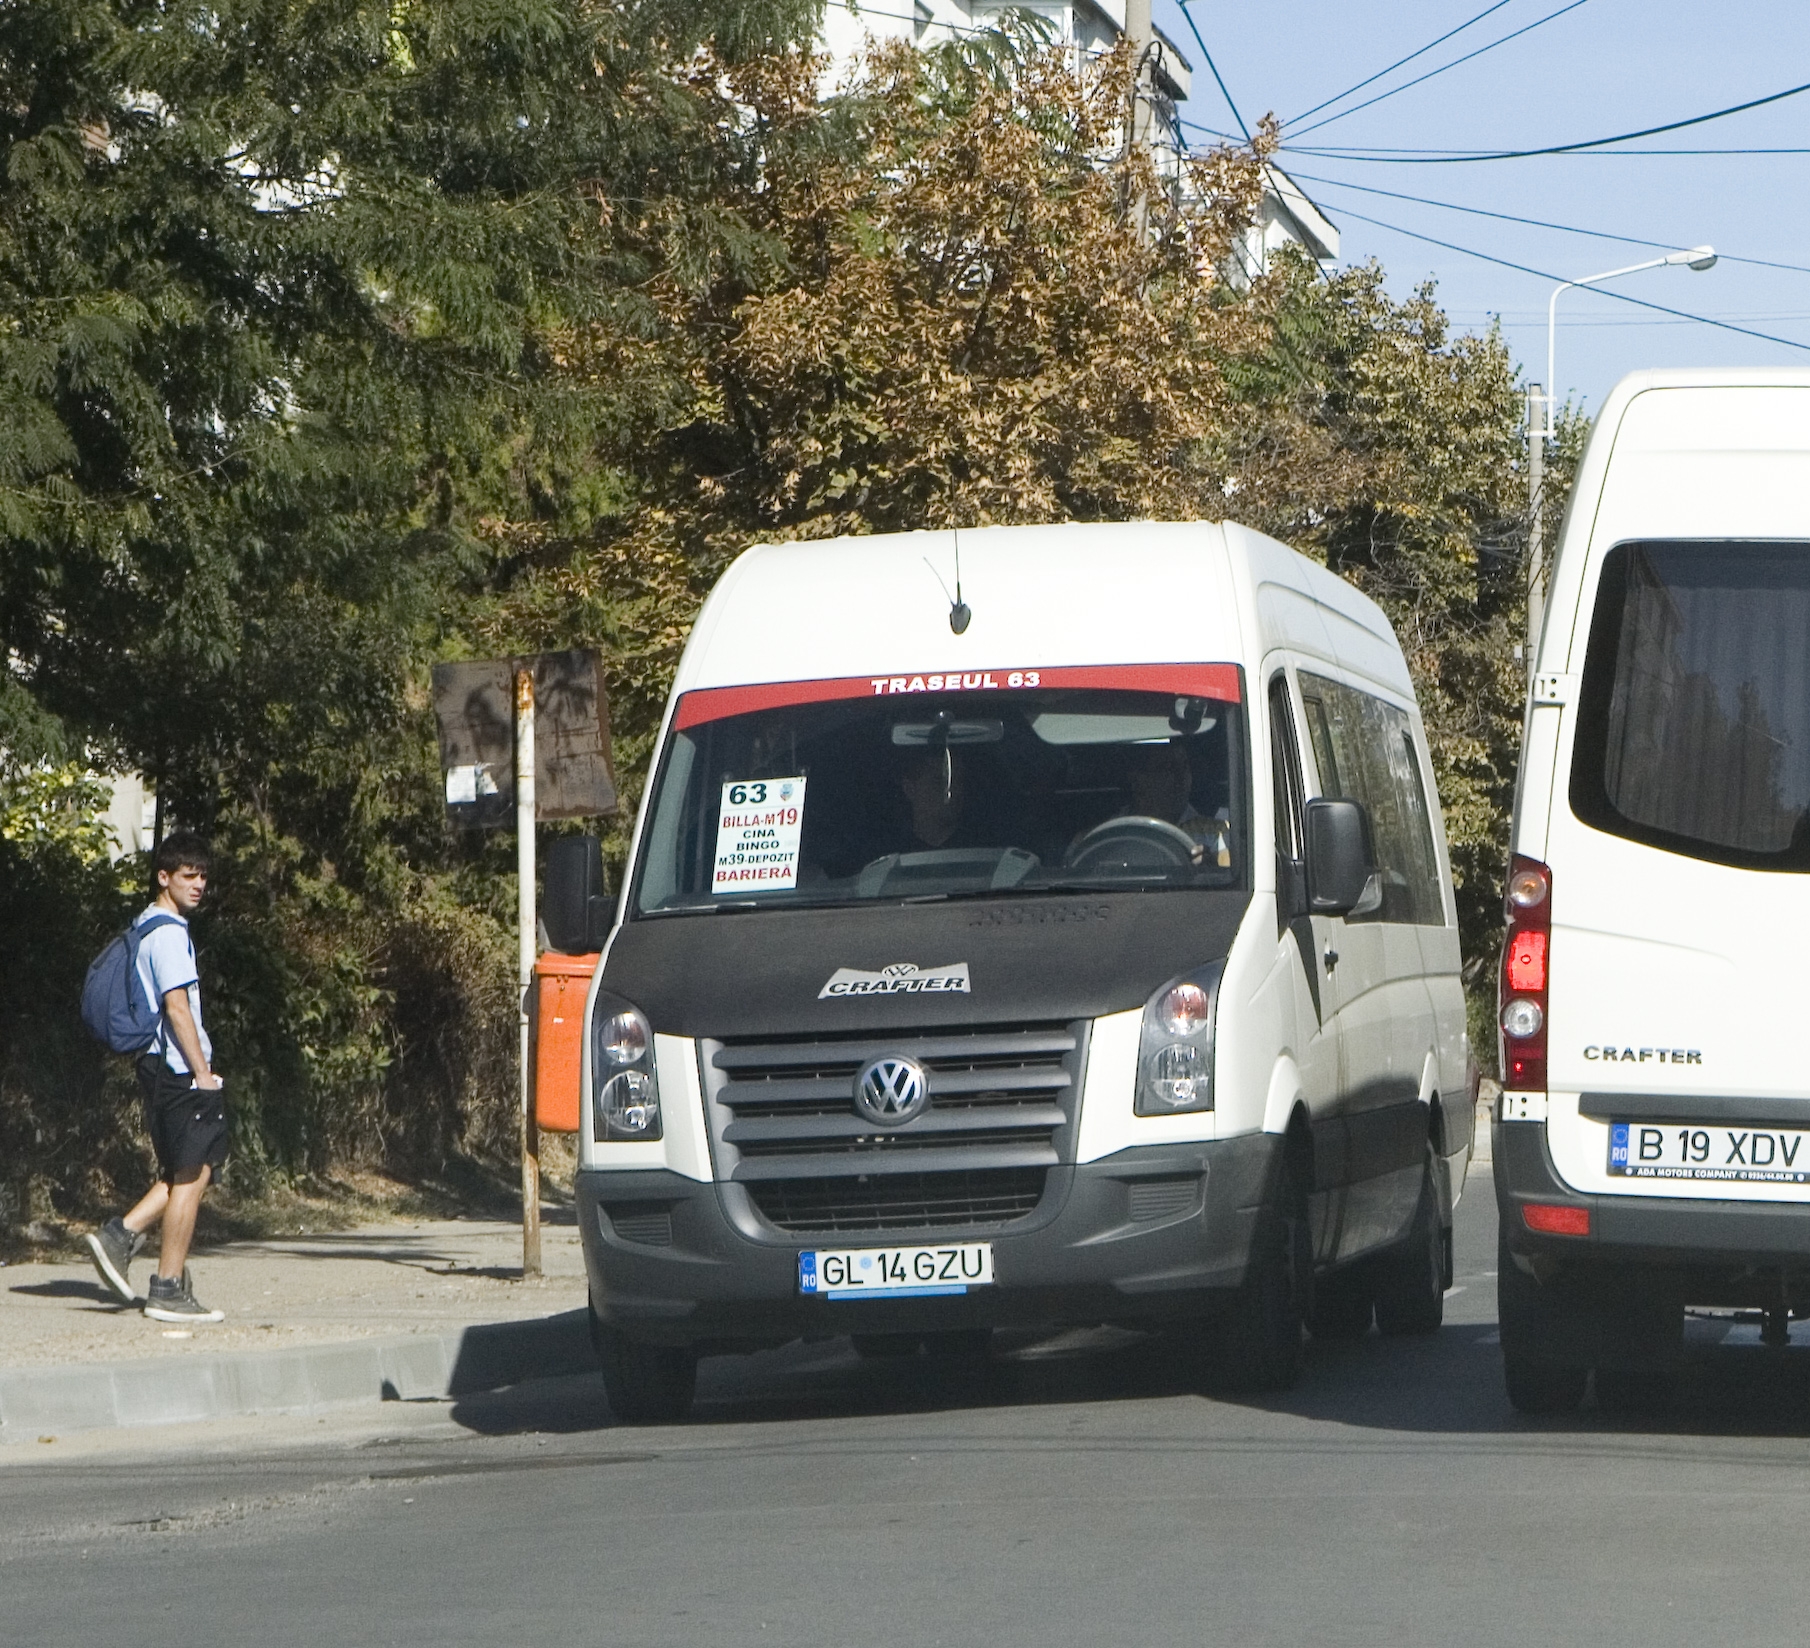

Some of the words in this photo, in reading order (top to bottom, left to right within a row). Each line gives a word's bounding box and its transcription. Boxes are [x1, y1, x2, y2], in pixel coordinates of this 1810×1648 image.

[870, 673, 999, 695] TRASEUL
[1007, 671, 1041, 688] 63
[729, 783, 767, 805] 63
[743, 829, 775, 839] CINA
[736, 840, 780, 851] BINGO
[829, 977, 965, 994] CRAFTER
[1583, 1045, 1702, 1065] CRAFTER
[1611, 1147, 1628, 1161] RO
[1639, 1128, 1664, 1161] B
[1678, 1129, 1710, 1163] 19
[1725, 1131, 1802, 1167] XDV
[1636, 1167, 1656, 1177] ADA
[1657, 1168, 1693, 1178] MOTORS
[1694, 1169, 1737, 1180] COMPANY
[823, 1255, 864, 1286] GL
[877, 1252, 907, 1283] 14
[914, 1248, 983, 1281] GZU
[802, 1273, 817, 1288] RO
